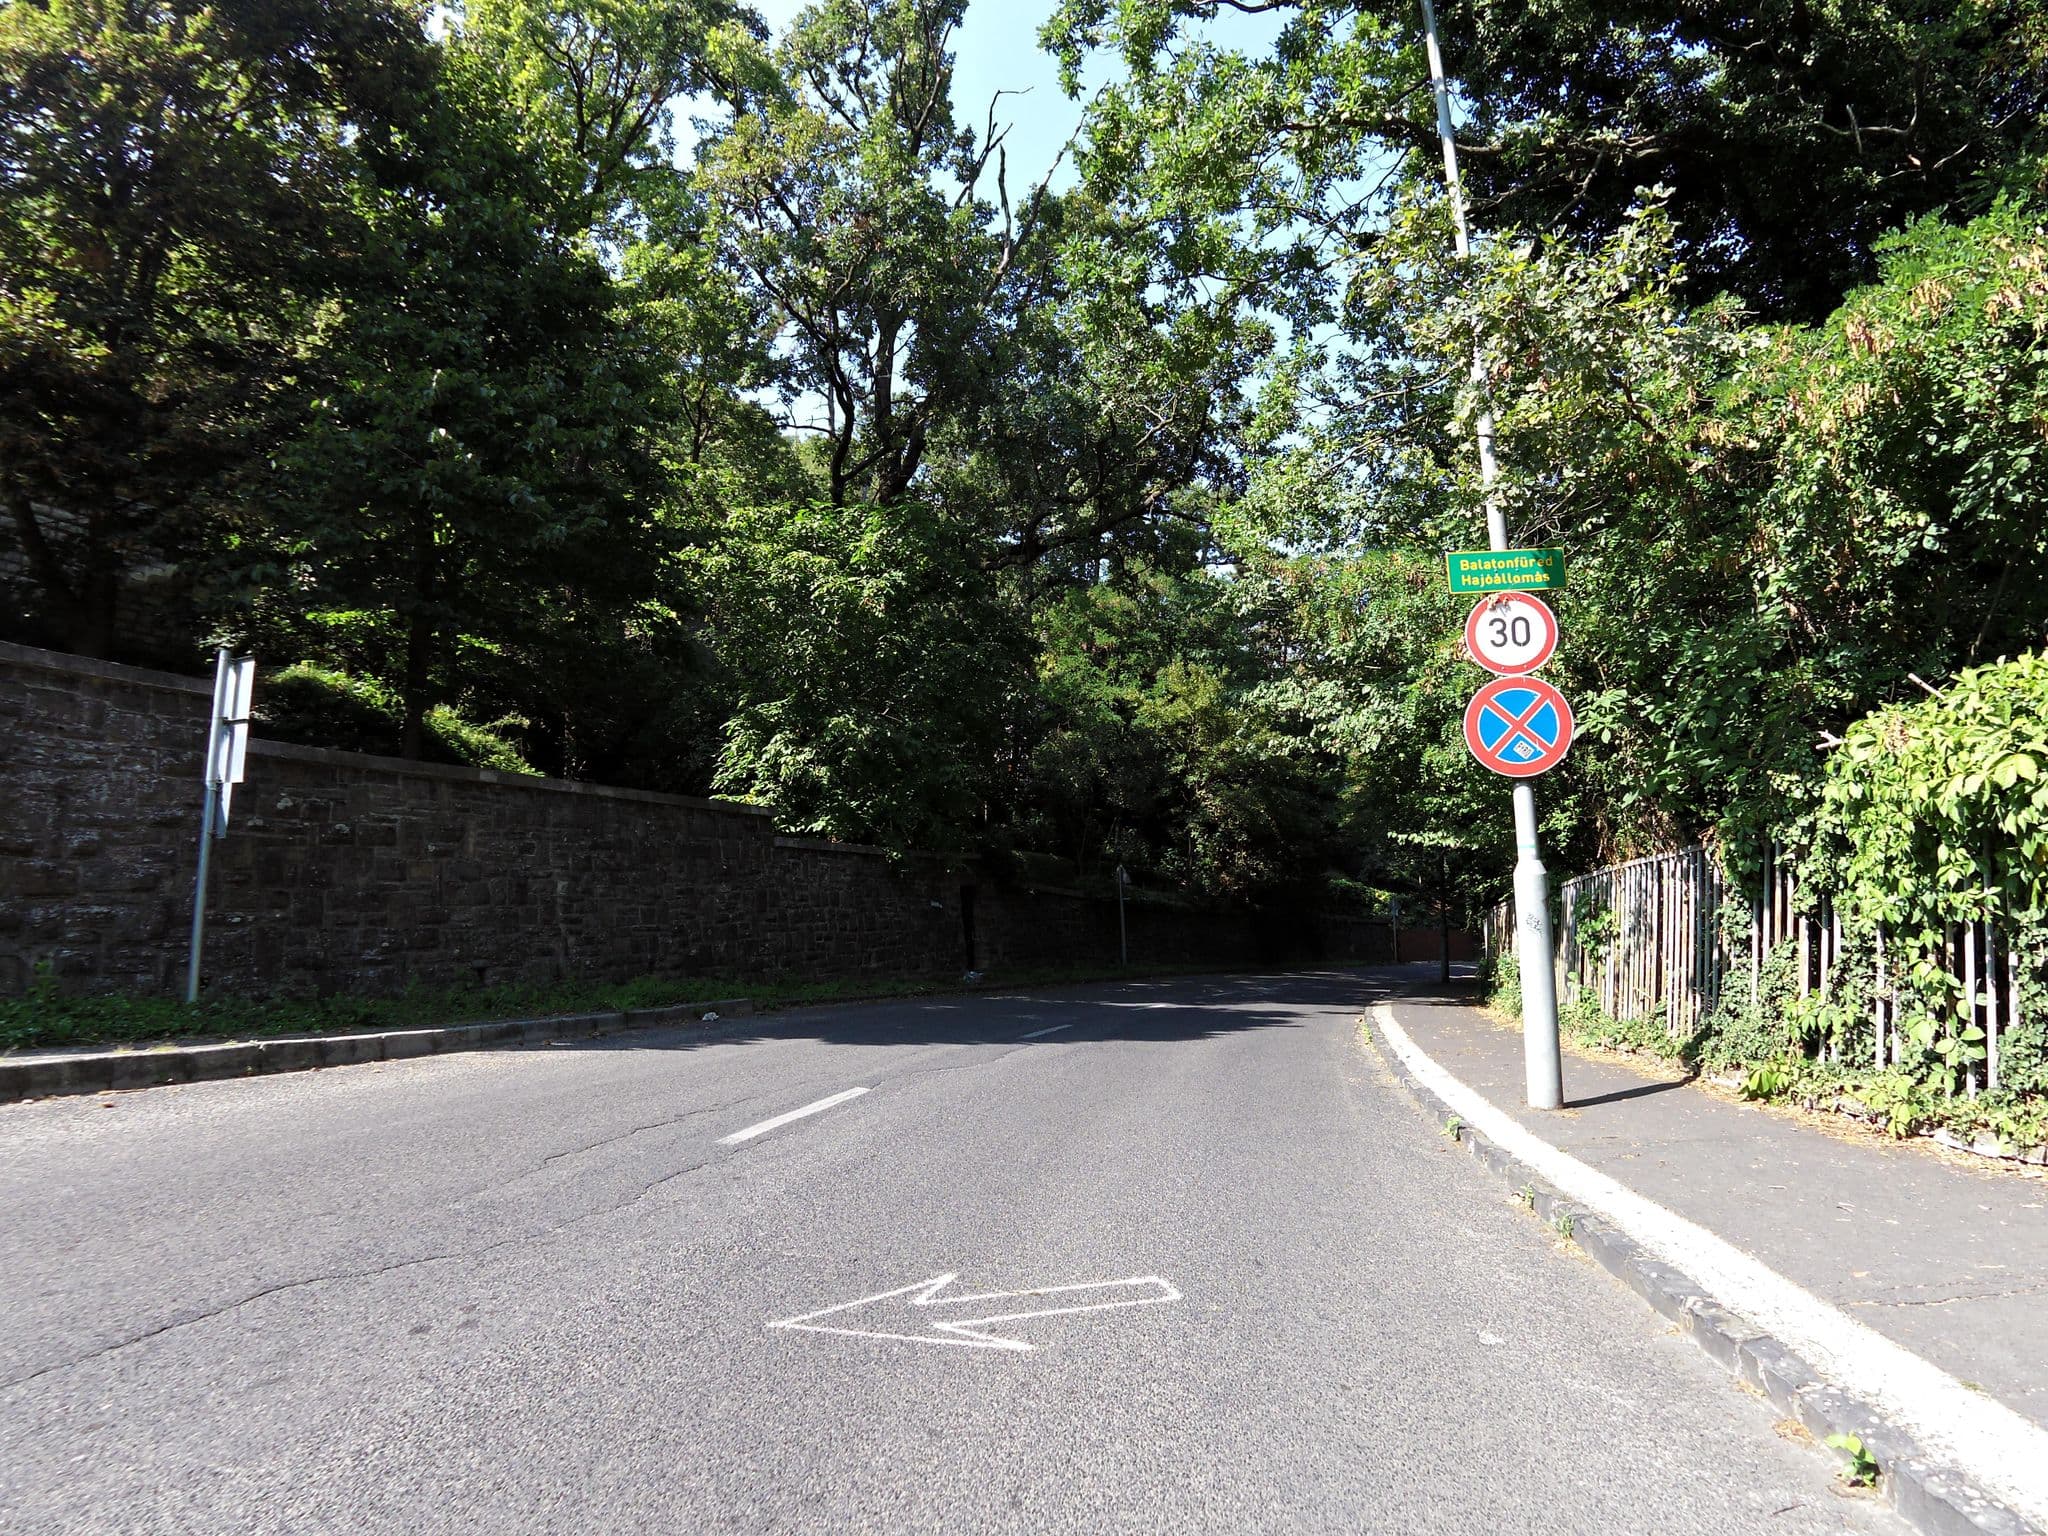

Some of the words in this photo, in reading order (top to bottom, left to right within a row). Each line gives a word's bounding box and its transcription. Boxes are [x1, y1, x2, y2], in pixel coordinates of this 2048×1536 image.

[1460, 556, 1553, 571] Balatonfüred
[1461, 571, 1550, 587] Hajóállomás
[1488, 616, 1531, 648] 30
